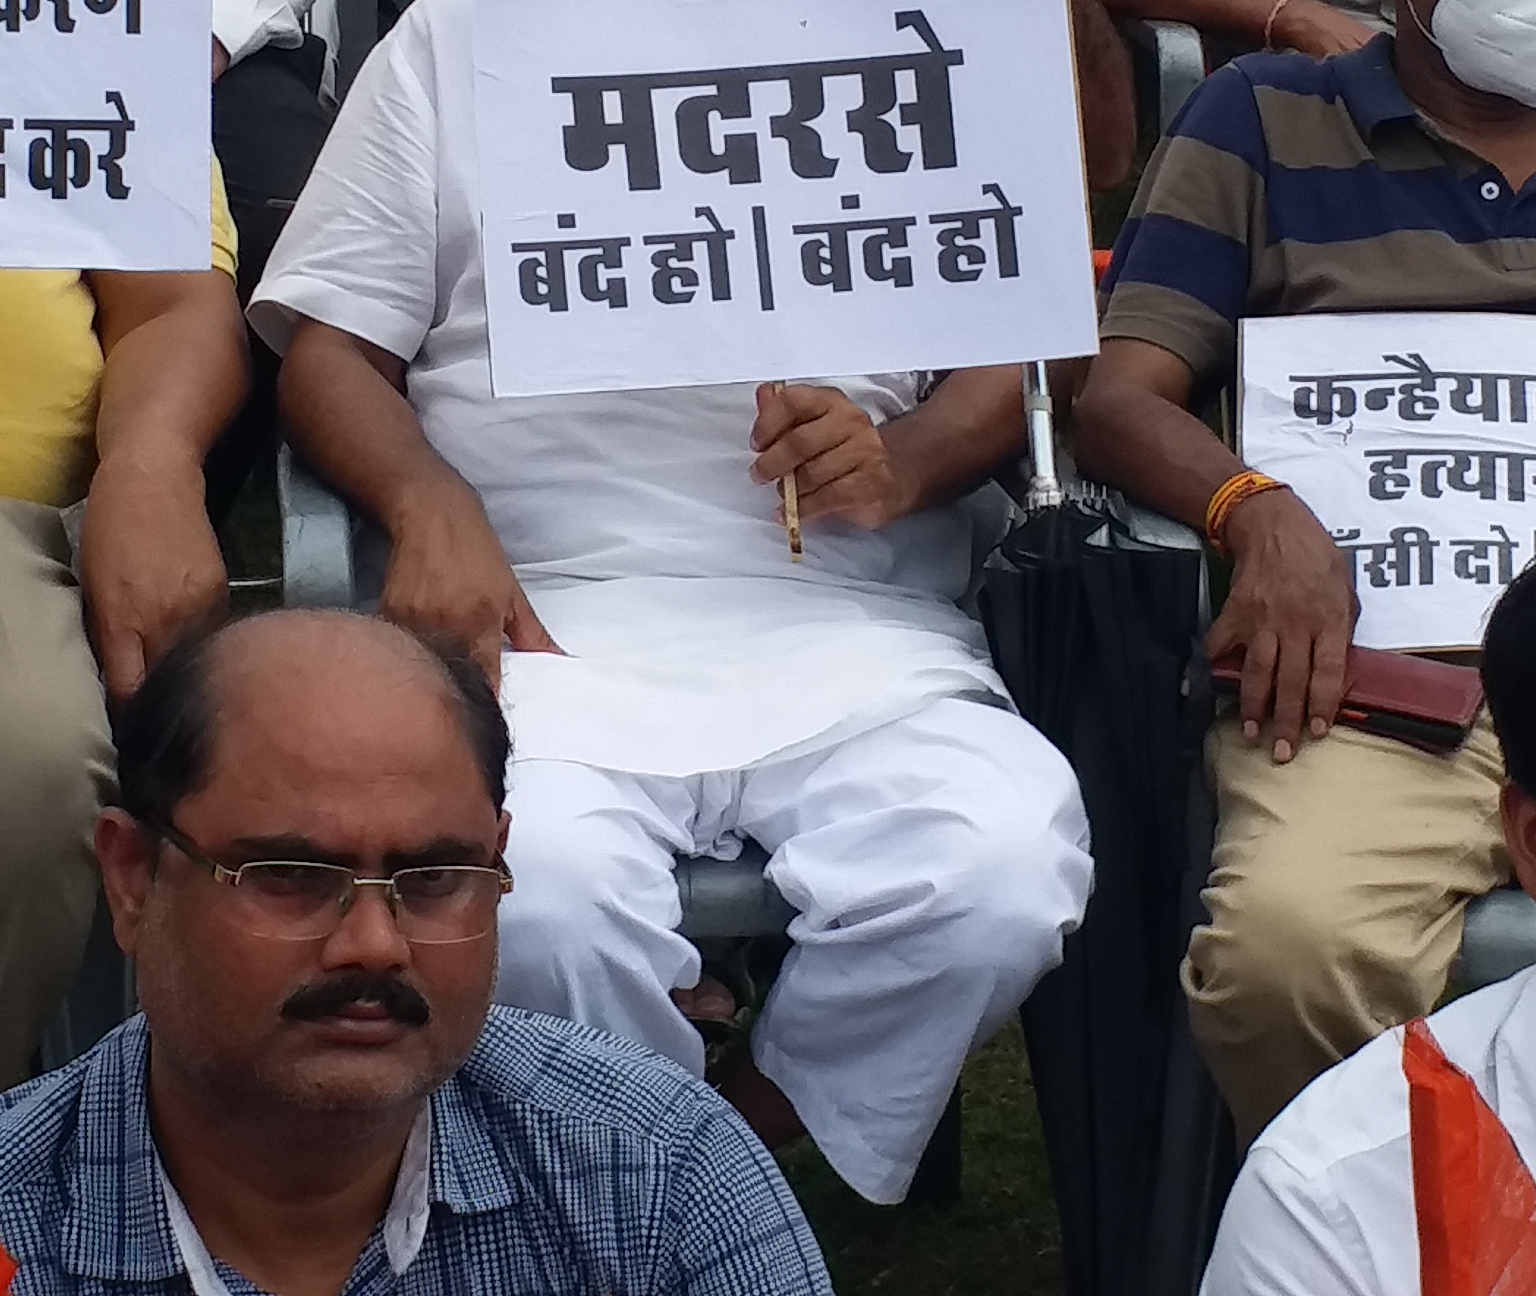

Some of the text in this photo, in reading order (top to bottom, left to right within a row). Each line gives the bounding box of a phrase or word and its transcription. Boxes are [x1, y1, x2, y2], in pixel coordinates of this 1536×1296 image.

[24, 91, 135, 200] करे
[550, 9, 964, 191] मदरसे
[511, 213, 631, 312] बंद
[643, 206, 736, 305] हो
[792, 194, 917, 293] बंद
[929, 183, 1023, 284] हो
[1449, 524, 1519, 586] दो
